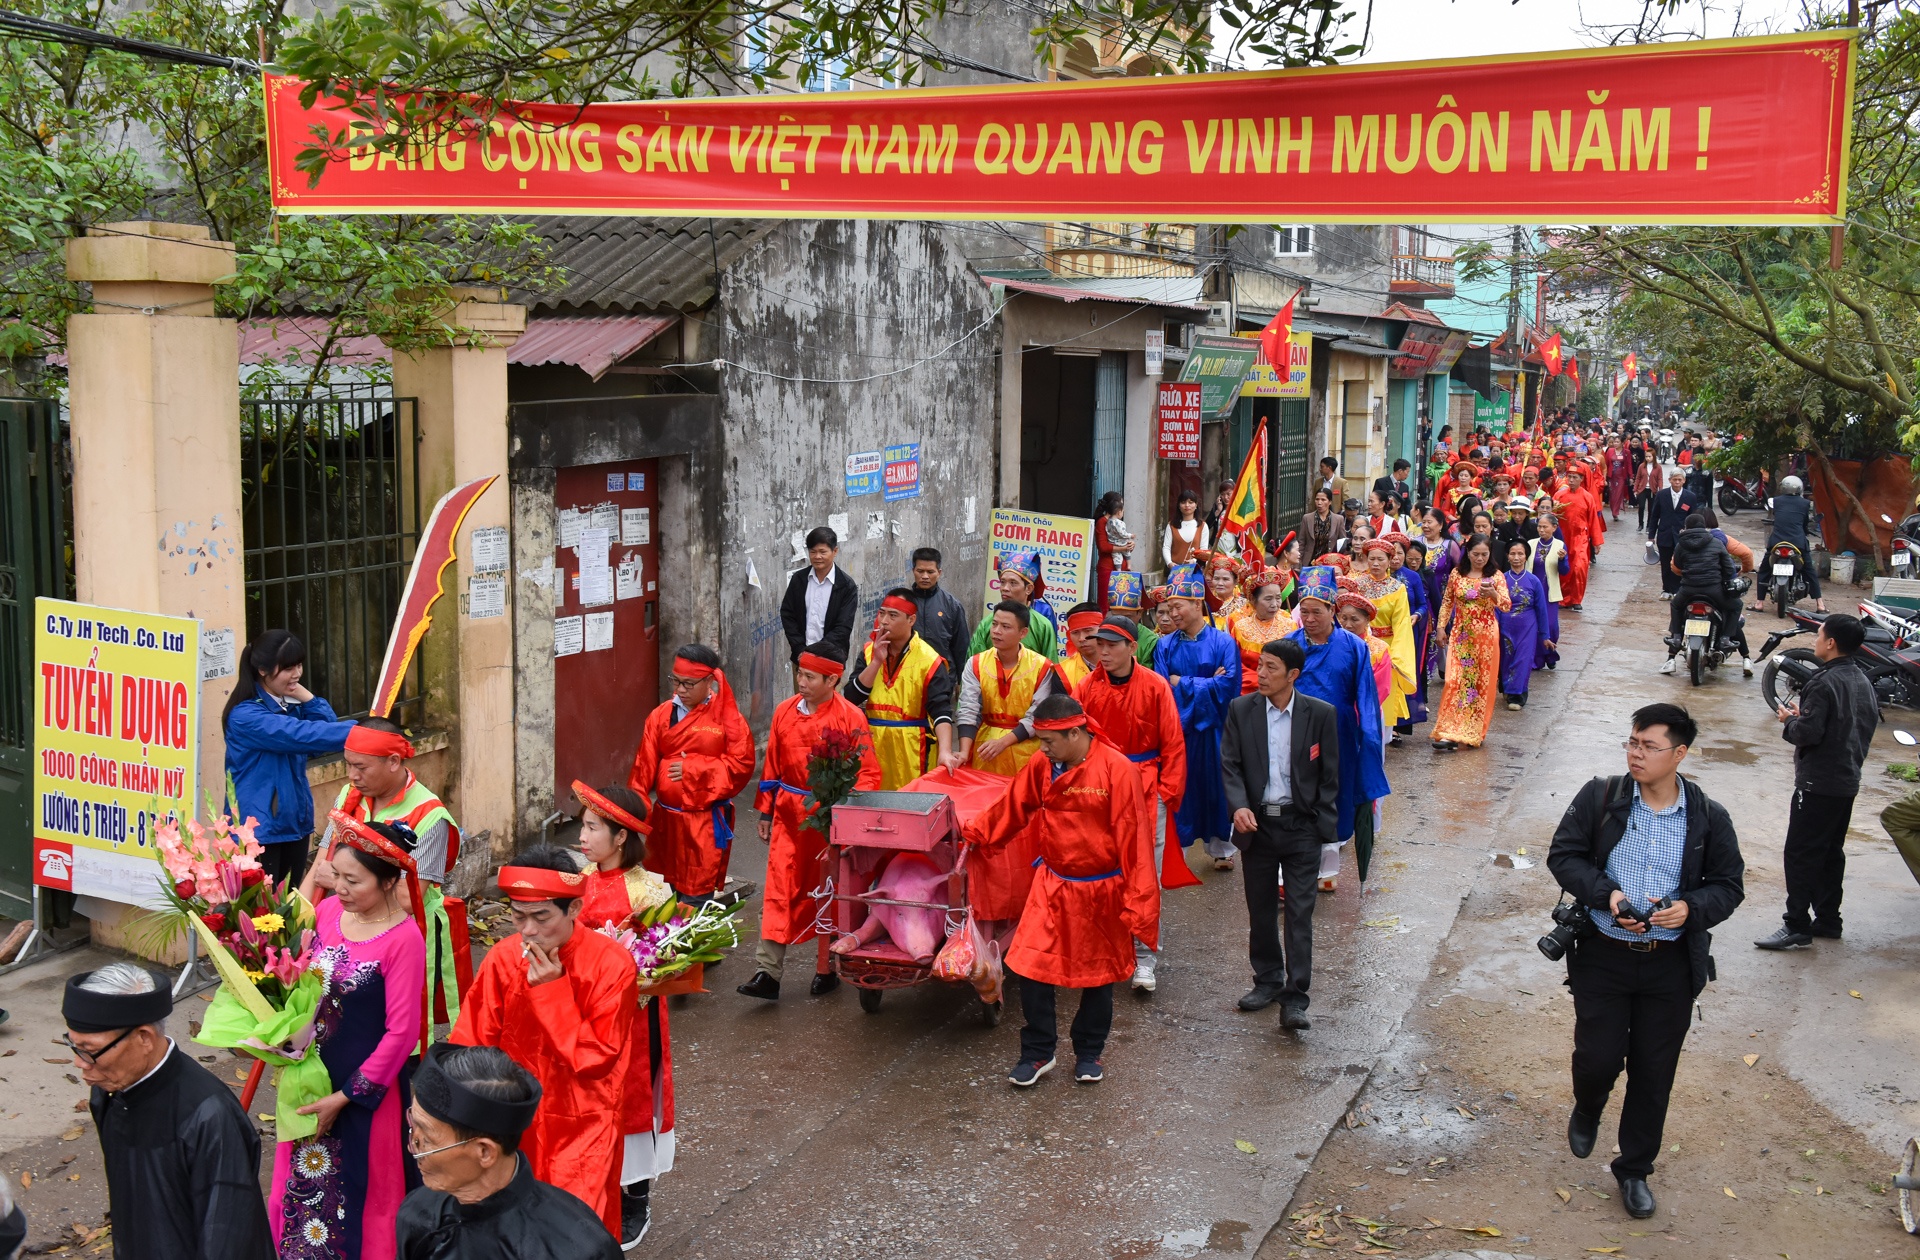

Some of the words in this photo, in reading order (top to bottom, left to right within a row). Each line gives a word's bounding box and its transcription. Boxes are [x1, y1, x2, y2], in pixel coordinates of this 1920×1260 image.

[481, 110, 602, 189] CỘNG
[615, 111, 714, 173] SẢN
[729, 115, 831, 190] VIỆT
[841, 124, 958, 174] NAM
[973, 120, 1164, 175] QUANG
[1182, 117, 1312, 174] VINH
[1331, 94, 1509, 174] MUÔN
[1530, 90, 1671, 172] NĂM
[1696, 107, 1712, 171] !
[1290, 370, 1306, 384] HỘP
[1160, 384, 1182, 406] RỬA
[1185, 391, 1199, 407] XE
[1161, 410, 1181, 419] THAY
[1163, 421, 1182, 431] BƠM
[1184, 420, 1195, 432] VÁ
[1161, 431, 1174, 442] SỬA
[1176, 433, 1184, 442] XE
[1186, 434, 1199, 444] ĐẠP
[1178, 443, 1197, 451] ÔM
[995, 512, 1009, 520] Bún
[1012, 514, 1030, 523] Minh
[1033, 517, 1052, 526] Châu
[993, 523, 1031, 541] CƠM
[1036, 528, 1083, 548] RANG
[993, 540, 1017, 551] BÚN
[1059, 549, 1080, 560] GIÒ
[47, 614, 73, 638] C.Ty
[77, 619, 92, 639] JH
[96, 622, 129, 644] Tech
[163, 631, 184, 652] Ltd
[42, 646, 113, 737] TUYỂN
[121, 675, 187, 756] DỤNG
[41, 749, 75, 780] 1000
[80, 752, 117, 787] CÔNG
[122, 761, 159, 794] NHÂN
[164, 767, 185, 799] NỮ
[43, 791, 78, 834] LƯƠNG
[83, 801, 90, 836] 6
[94, 800, 126, 848] TRIỆU
[138, 811, 146, 847] 8
